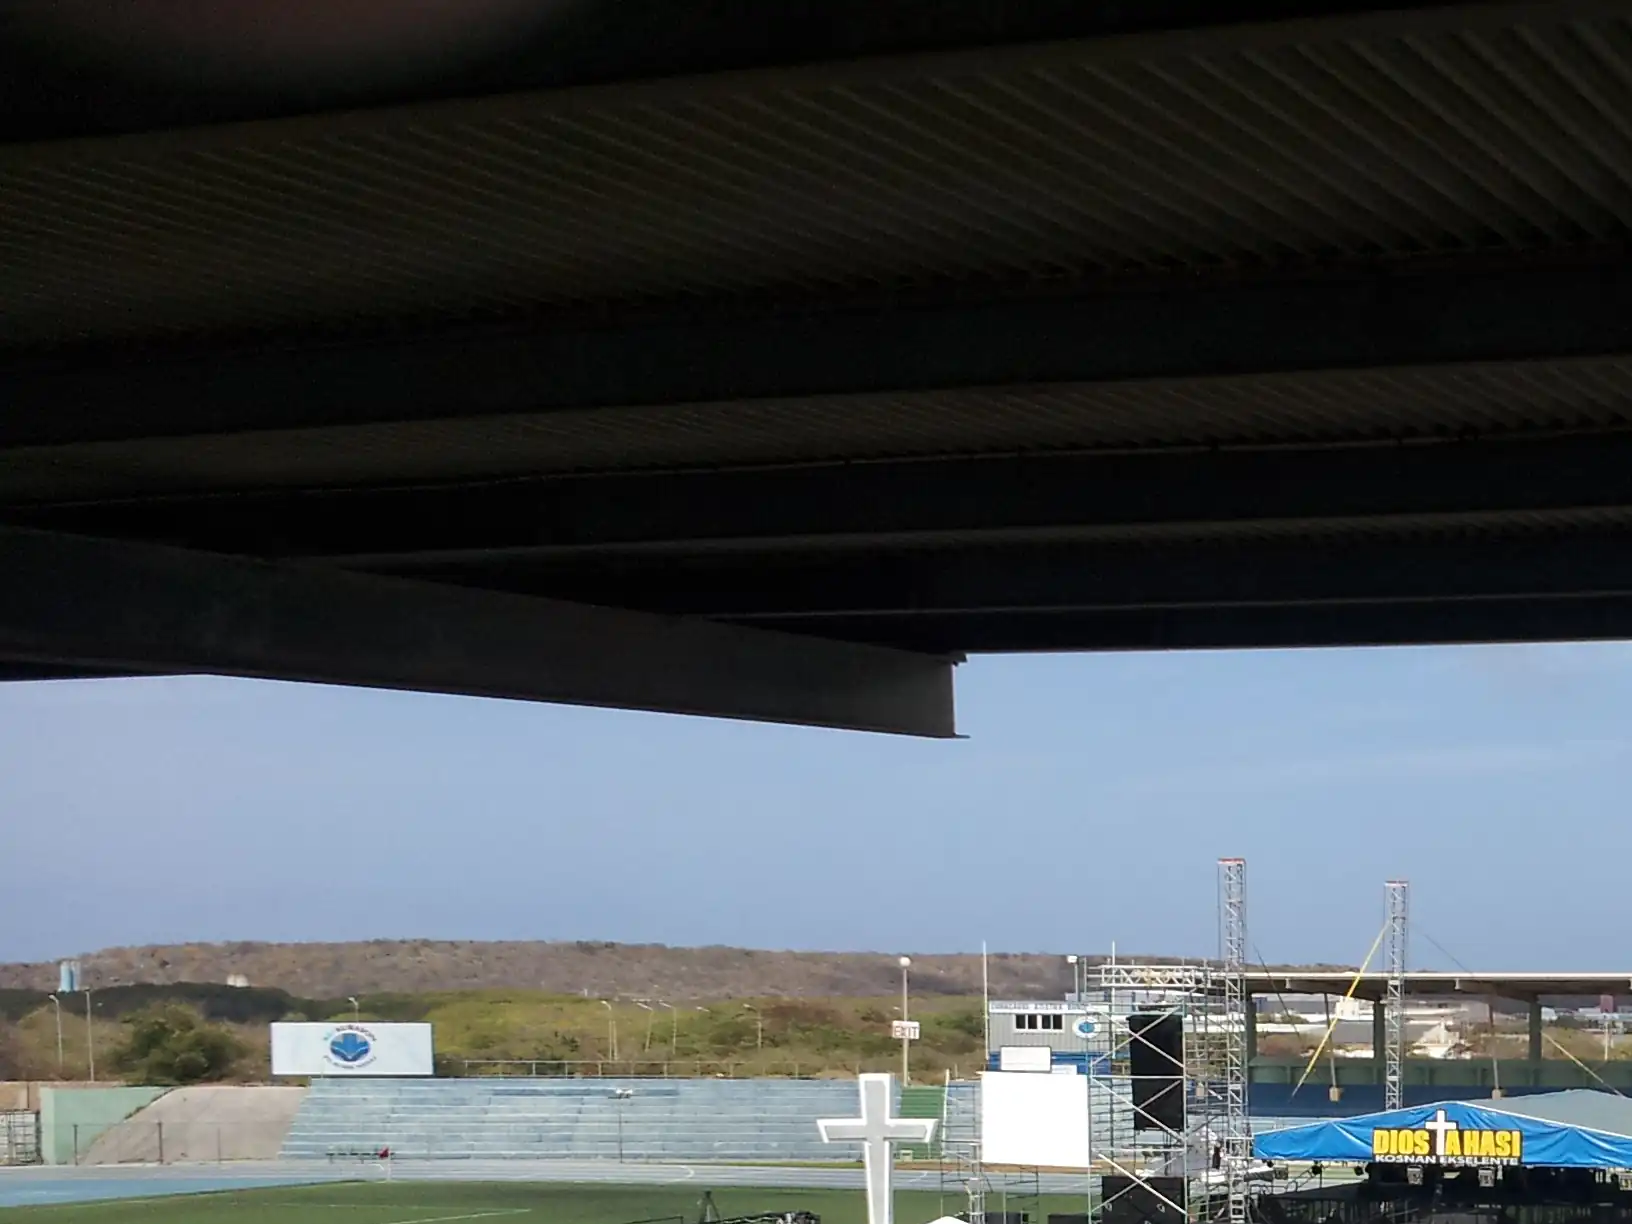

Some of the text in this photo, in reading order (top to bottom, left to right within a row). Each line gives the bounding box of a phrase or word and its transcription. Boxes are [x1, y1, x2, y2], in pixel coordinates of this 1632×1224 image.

[894, 1025, 918, 1037] EXIT
[1373, 1129, 1430, 1155] DIOS
[1463, 1130, 1522, 1157] HASI
[1375, 1155, 1518, 1166] KOSNAN EKSELENTE
